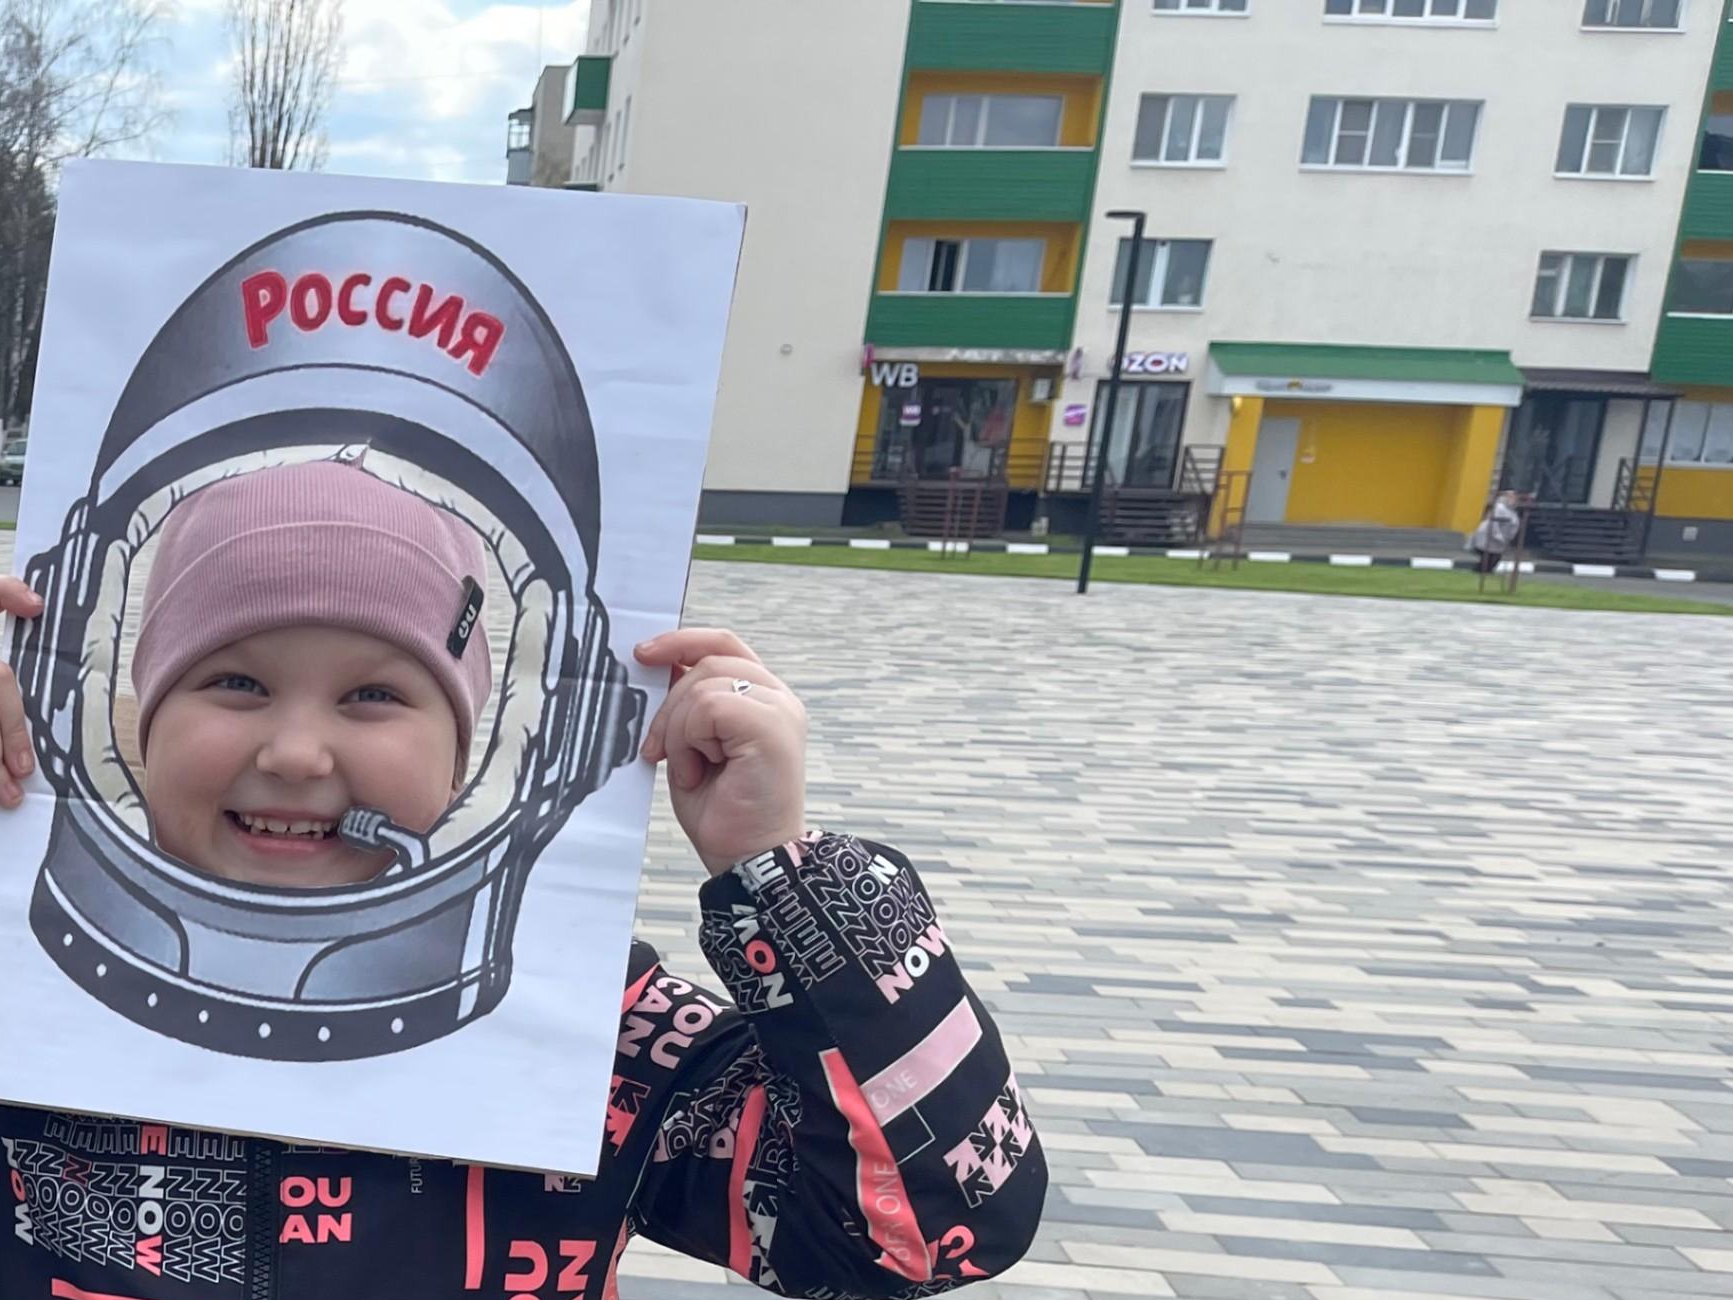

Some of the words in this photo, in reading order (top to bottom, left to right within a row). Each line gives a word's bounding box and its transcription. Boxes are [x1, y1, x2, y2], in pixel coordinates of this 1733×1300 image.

[241, 271, 505, 376] РОССИЯ
[871, 362, 918, 387] WB
[876, 923, 952, 1004] NOW
[618, 977, 693, 1058] CAN
[136, 1165, 164, 1277] NOW
